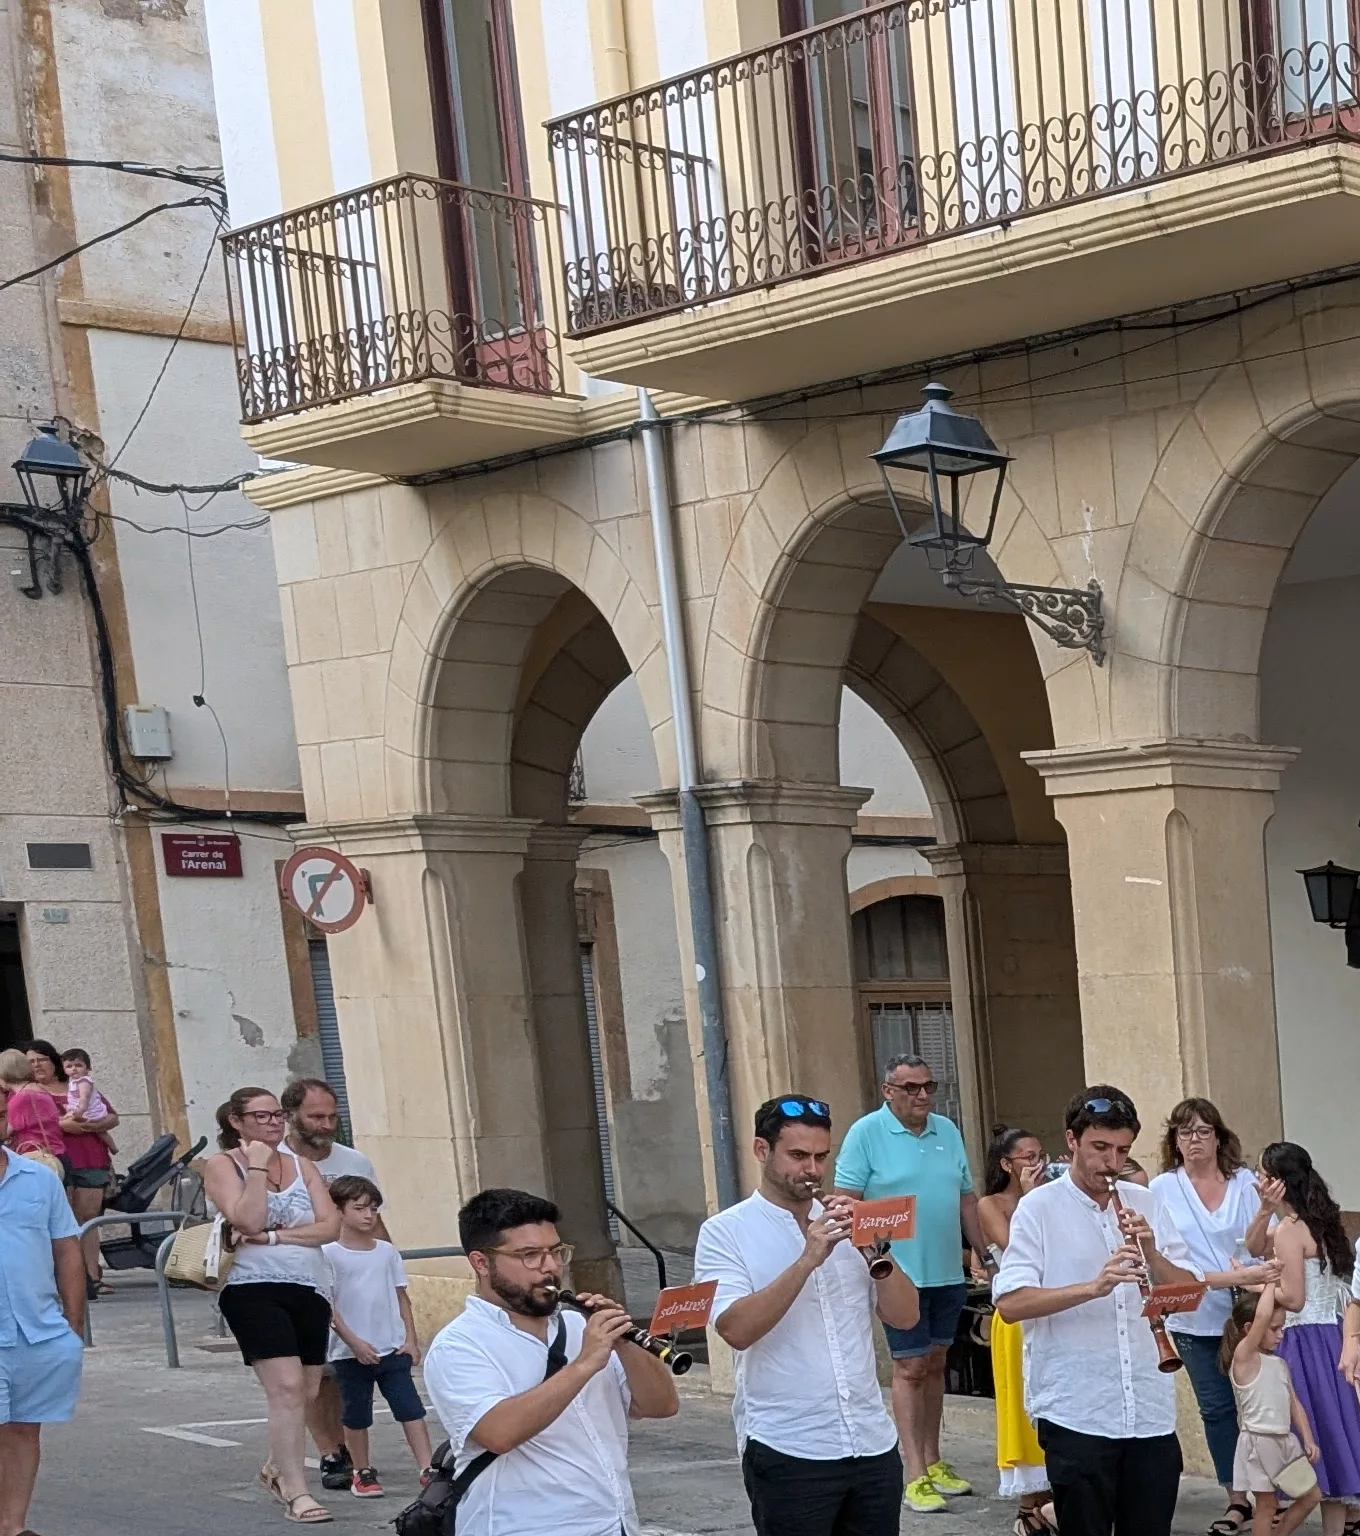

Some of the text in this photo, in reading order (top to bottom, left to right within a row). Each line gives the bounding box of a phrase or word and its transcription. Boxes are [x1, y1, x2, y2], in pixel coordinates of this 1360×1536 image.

[181, 850, 224, 859] Carrer de
[181, 860, 227, 870] l'Arenal
